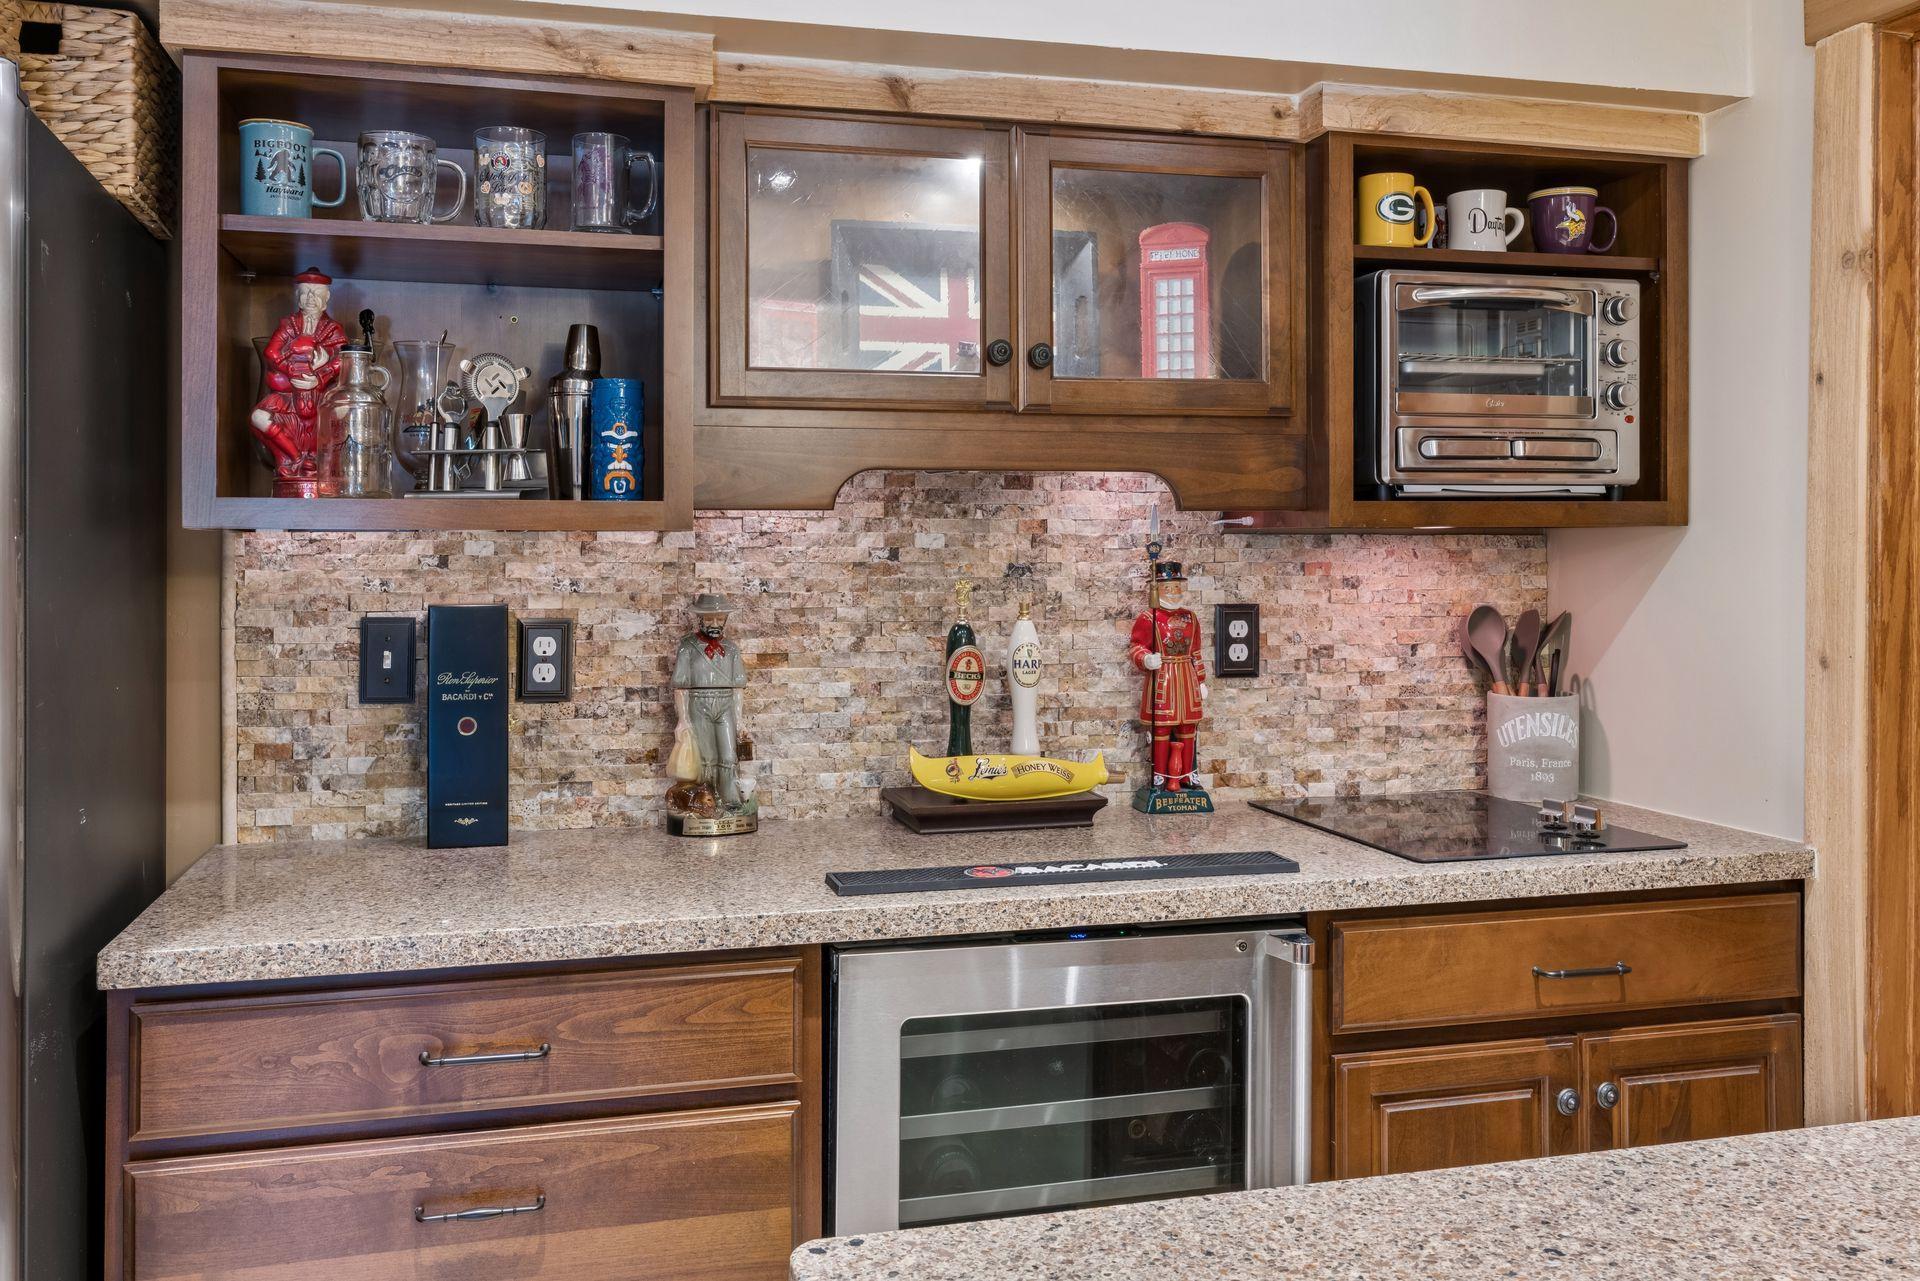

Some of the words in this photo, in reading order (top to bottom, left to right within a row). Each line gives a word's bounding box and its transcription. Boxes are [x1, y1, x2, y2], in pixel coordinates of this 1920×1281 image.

[254, 139, 307, 154] BIGFOOT
[265, 185, 304, 198] Hayward
[1014, 659, 1042, 670] HARP
[437, 672, 460, 685] Ron
[460, 671, 499, 689] Superior
[442, 693, 477, 701] BACARDI
[968, 757, 1009, 781] Leinie's
[1016, 762, 1047, 775] HONEY
[1048, 762, 1072, 780] WEISS
[1510, 756, 1539, 769] Paris,
[1541, 758, 1572, 768] France
[1156, 796, 1207, 810] BEEFEATER
